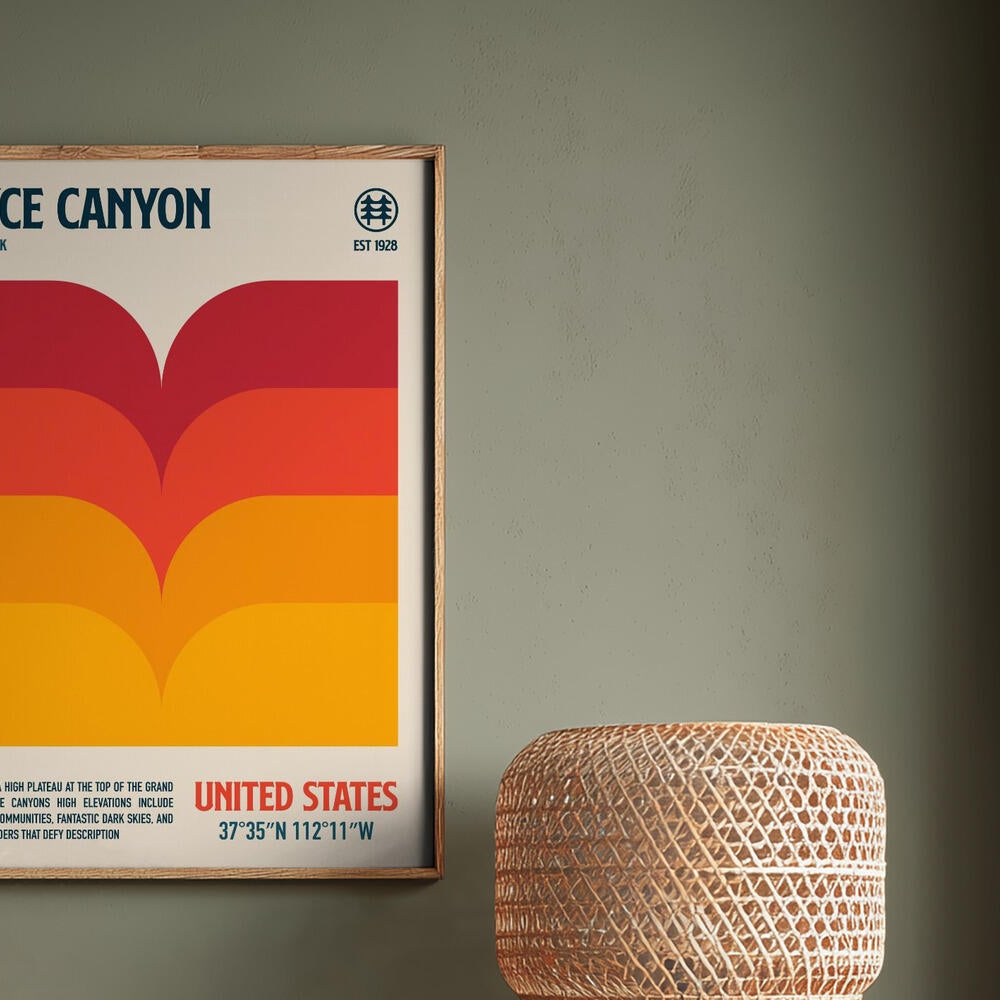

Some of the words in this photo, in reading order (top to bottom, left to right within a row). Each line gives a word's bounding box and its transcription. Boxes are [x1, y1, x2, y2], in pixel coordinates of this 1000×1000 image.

[57, 188, 210, 229] CANYON
[353, 239, 372, 252] EST
[374, 239, 399, 252] 1928
[4, 781, 25, 793] HIGH
[27, 781, 63, 793] PLATEAU
[64, 781, 76, 793] AT
[76, 781, 93, 793] THE
[94, 781, 111, 793] TOP
[113, 781, 125, 793] OF
[126, 781, 143, 793] THE
[145, 781, 174, 793] GRAND
[11, 797, 51, 808] CANYONS
[56, 797, 77, 808] HIGH
[83, 797, 132, 808] ELEVATIONS
[138, 797, 174, 809] INCLUDE
[195, 782, 293, 811] UNITED
[303, 782, 398, 811] STATES
[56, 812, 100, 824] FANTASTIC
[102, 812, 125, 824] DARK
[126, 812, 154, 825] SKIES,
[155, 812, 174, 824] AND
[20, 828, 42, 840] THAT
[42, 828, 64, 840] DEFY
[65, 828, 120, 840] DESCRIPTION
